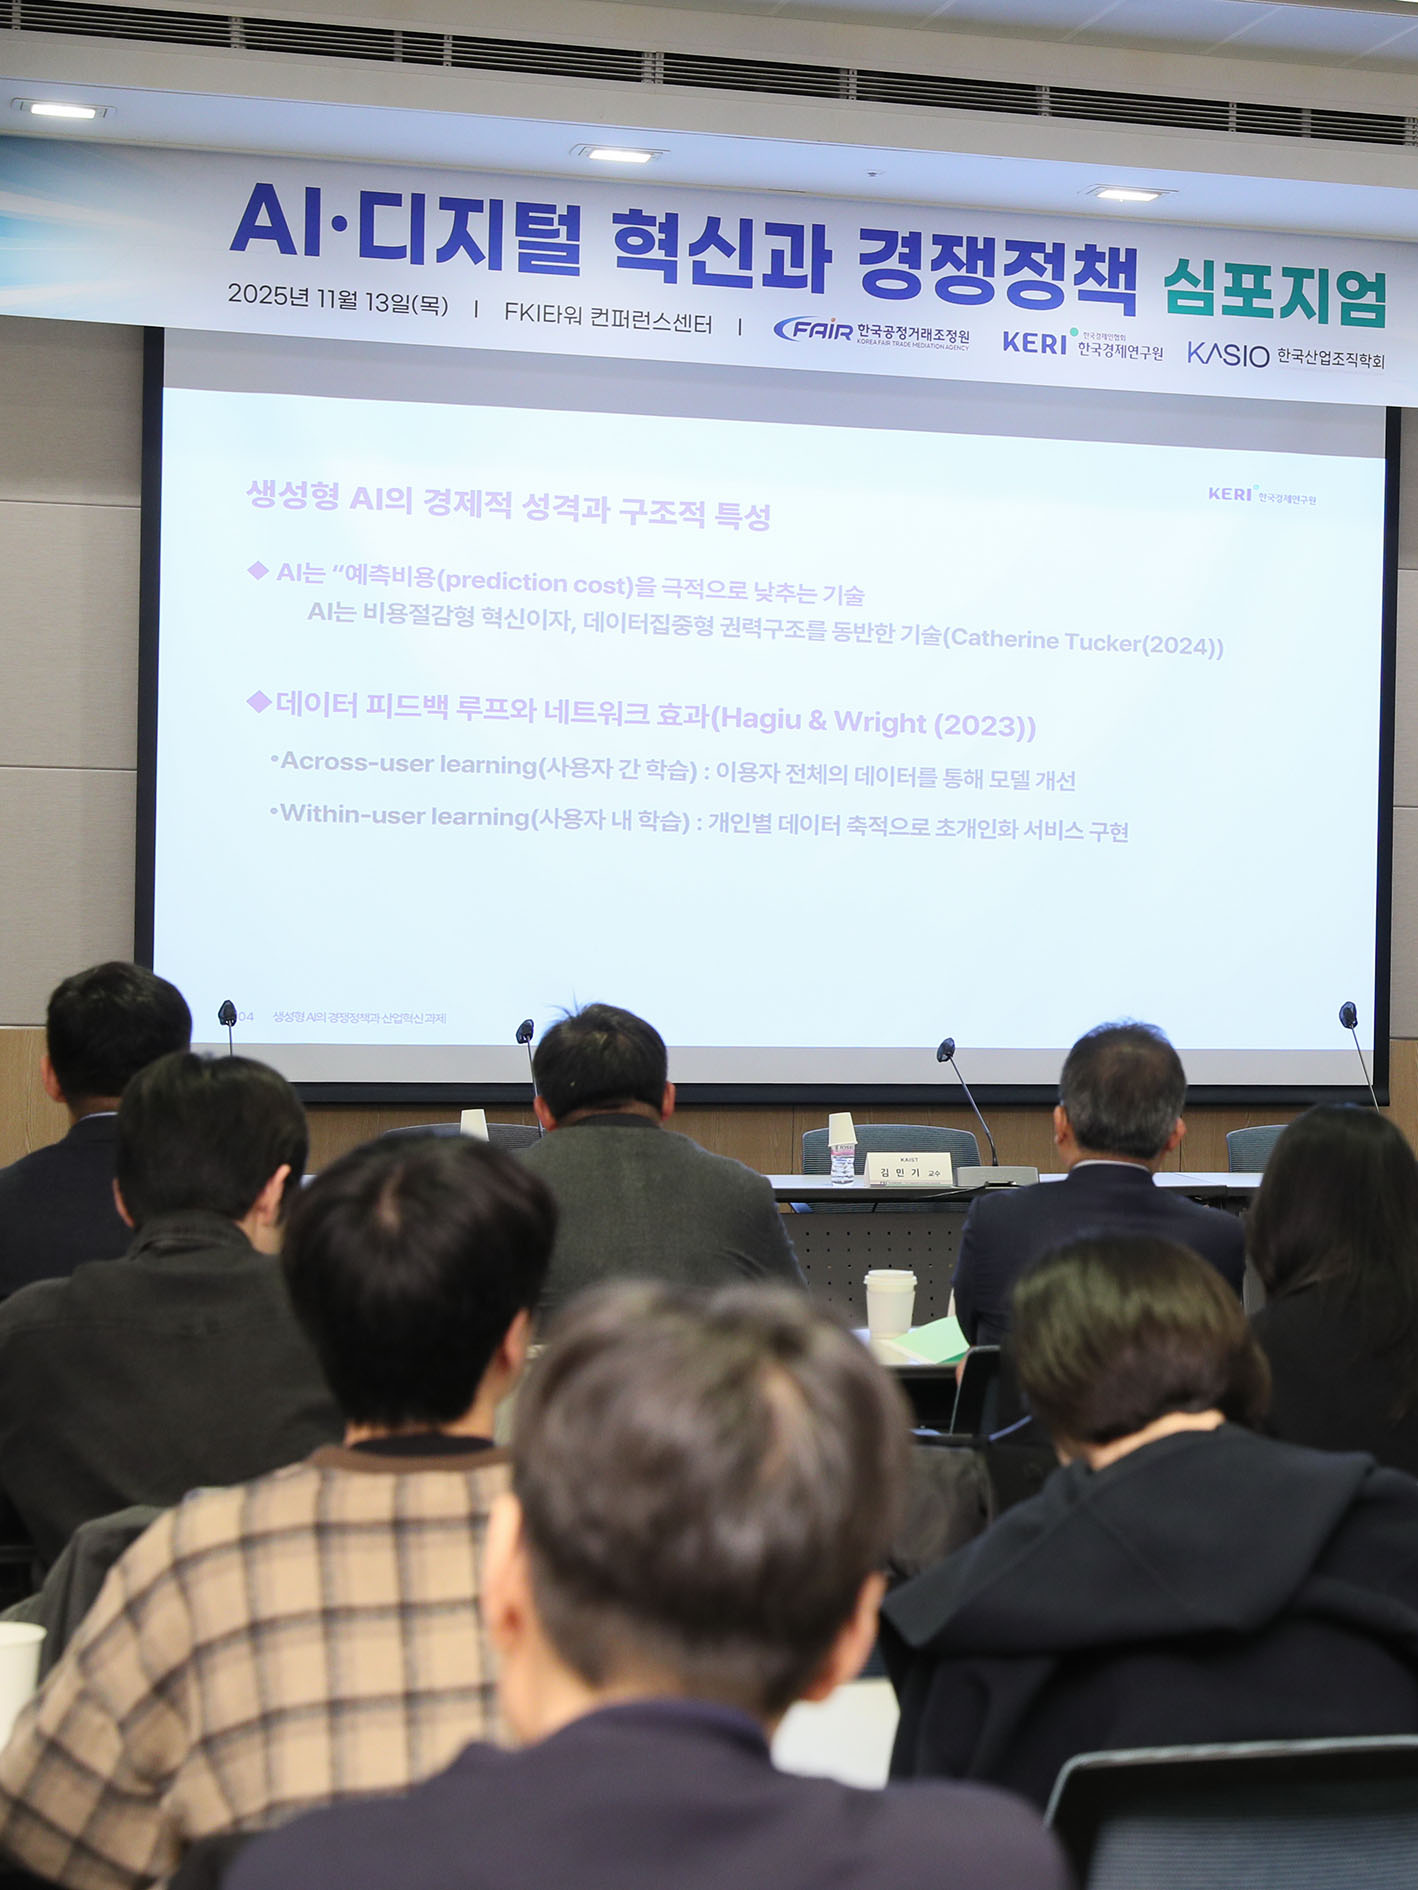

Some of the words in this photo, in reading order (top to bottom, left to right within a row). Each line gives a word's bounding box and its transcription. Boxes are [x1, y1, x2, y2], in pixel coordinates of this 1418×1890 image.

[613, 208, 832, 294] 혁신과
[860, 228, 1137, 316] 경쟁정책
[1165, 258, 1385, 328] 심포지엄
[229, 283, 308, 307] 2025년
[318, 289, 356, 310] 11월
[366, 293, 447, 316] 13일(목)
[506, 302, 581, 325] FKI타워
[592, 308, 711, 334] 컨퍼런스센터
[856, 338, 877, 347] KOREA
[892, 340, 912, 348] TRADE
[912, 342, 945, 350] MEDIATION
[945, 344, 970, 352] AGENCY
[857, 323, 970, 345] 한국공정거래조정원
[1004, 331, 1066, 355] KERI
[1079, 340, 1163, 361] 한국경제연구원
[1188, 342, 1270, 368] KASIO
[1278, 348, 1384, 369] 한국산업조직학회
[246, 480, 338, 510] 생성형
[350, 487, 412, 515] AI의
[424, 488, 512, 519] 경제적
[522, 493, 611, 524] 성격과
[619, 499, 704, 529] 구조적
[715, 503, 770, 531] 특성
[1209, 488, 1251, 501] KERI
[1259, 493, 1316, 505] 한국경제연구원
[277, 563, 326, 584] AI는
[574, 576, 656, 599] cost)을
[662, 578, 748, 600] 극적으로
[755, 582, 817, 604] 낮추는
[823, 585, 864, 606] 기술
[308, 602, 357, 622] AI는
[364, 602, 474, 627] 비용절감형
[482, 607, 576, 634] 혁신이자,
[584, 611, 713, 636] 데이터집중형
[720, 617, 827, 641] 권력구조를
[832, 622, 896, 644] 동반한
[901, 624, 1059, 649] 기술(Catherine
[1065, 633, 1223, 660] Tucker(2024))
[277, 691, 357, 718] 데이터
[367, 693, 448, 720] 피드백
[456, 696, 537, 723] 루프와
[545, 699, 650, 726] 네트워크
[657, 703, 801, 734] 효과(Hagiu
[809, 709, 827, 730] &
[834, 711, 927, 738] Wright
[935, 713, 1036, 743] (2023))
[281, 751, 434, 772] Across-user
[441, 755, 614, 780] learning(사용자
[619, 759, 641, 779] 간
[646, 759, 696, 784] 학습)
[717, 761, 781, 784] 이용자
[786, 764, 847, 785] 전체의
[855, 766, 938, 788] 데이터를
[943, 768, 983, 789] 통해
[989, 770, 1030, 790] 모델
[1036, 771, 1075, 791] 개선
[280, 804, 426, 824] Within-user
[432, 808, 606, 831] learning(사용자
[612, 810, 631, 831] 내
[638, 810, 689, 835] 학습)
[709, 812, 771, 834] 개인별
[779, 814, 840, 836] 데이터
[847, 816, 930, 837] 축적으로
[936, 818, 1019, 839] 초개인화
[1024, 820, 1084, 841] 서비스
[1089, 822, 1128, 843] 구현
[272, 1011, 306, 1024] 생성형
[305, 1011, 327, 1024] AI의
[327, 1011, 381, 1025] 경쟁정책과
[381, 1012, 424, 1026] 산업혁신
[424, 1012, 448, 1025] 과제
